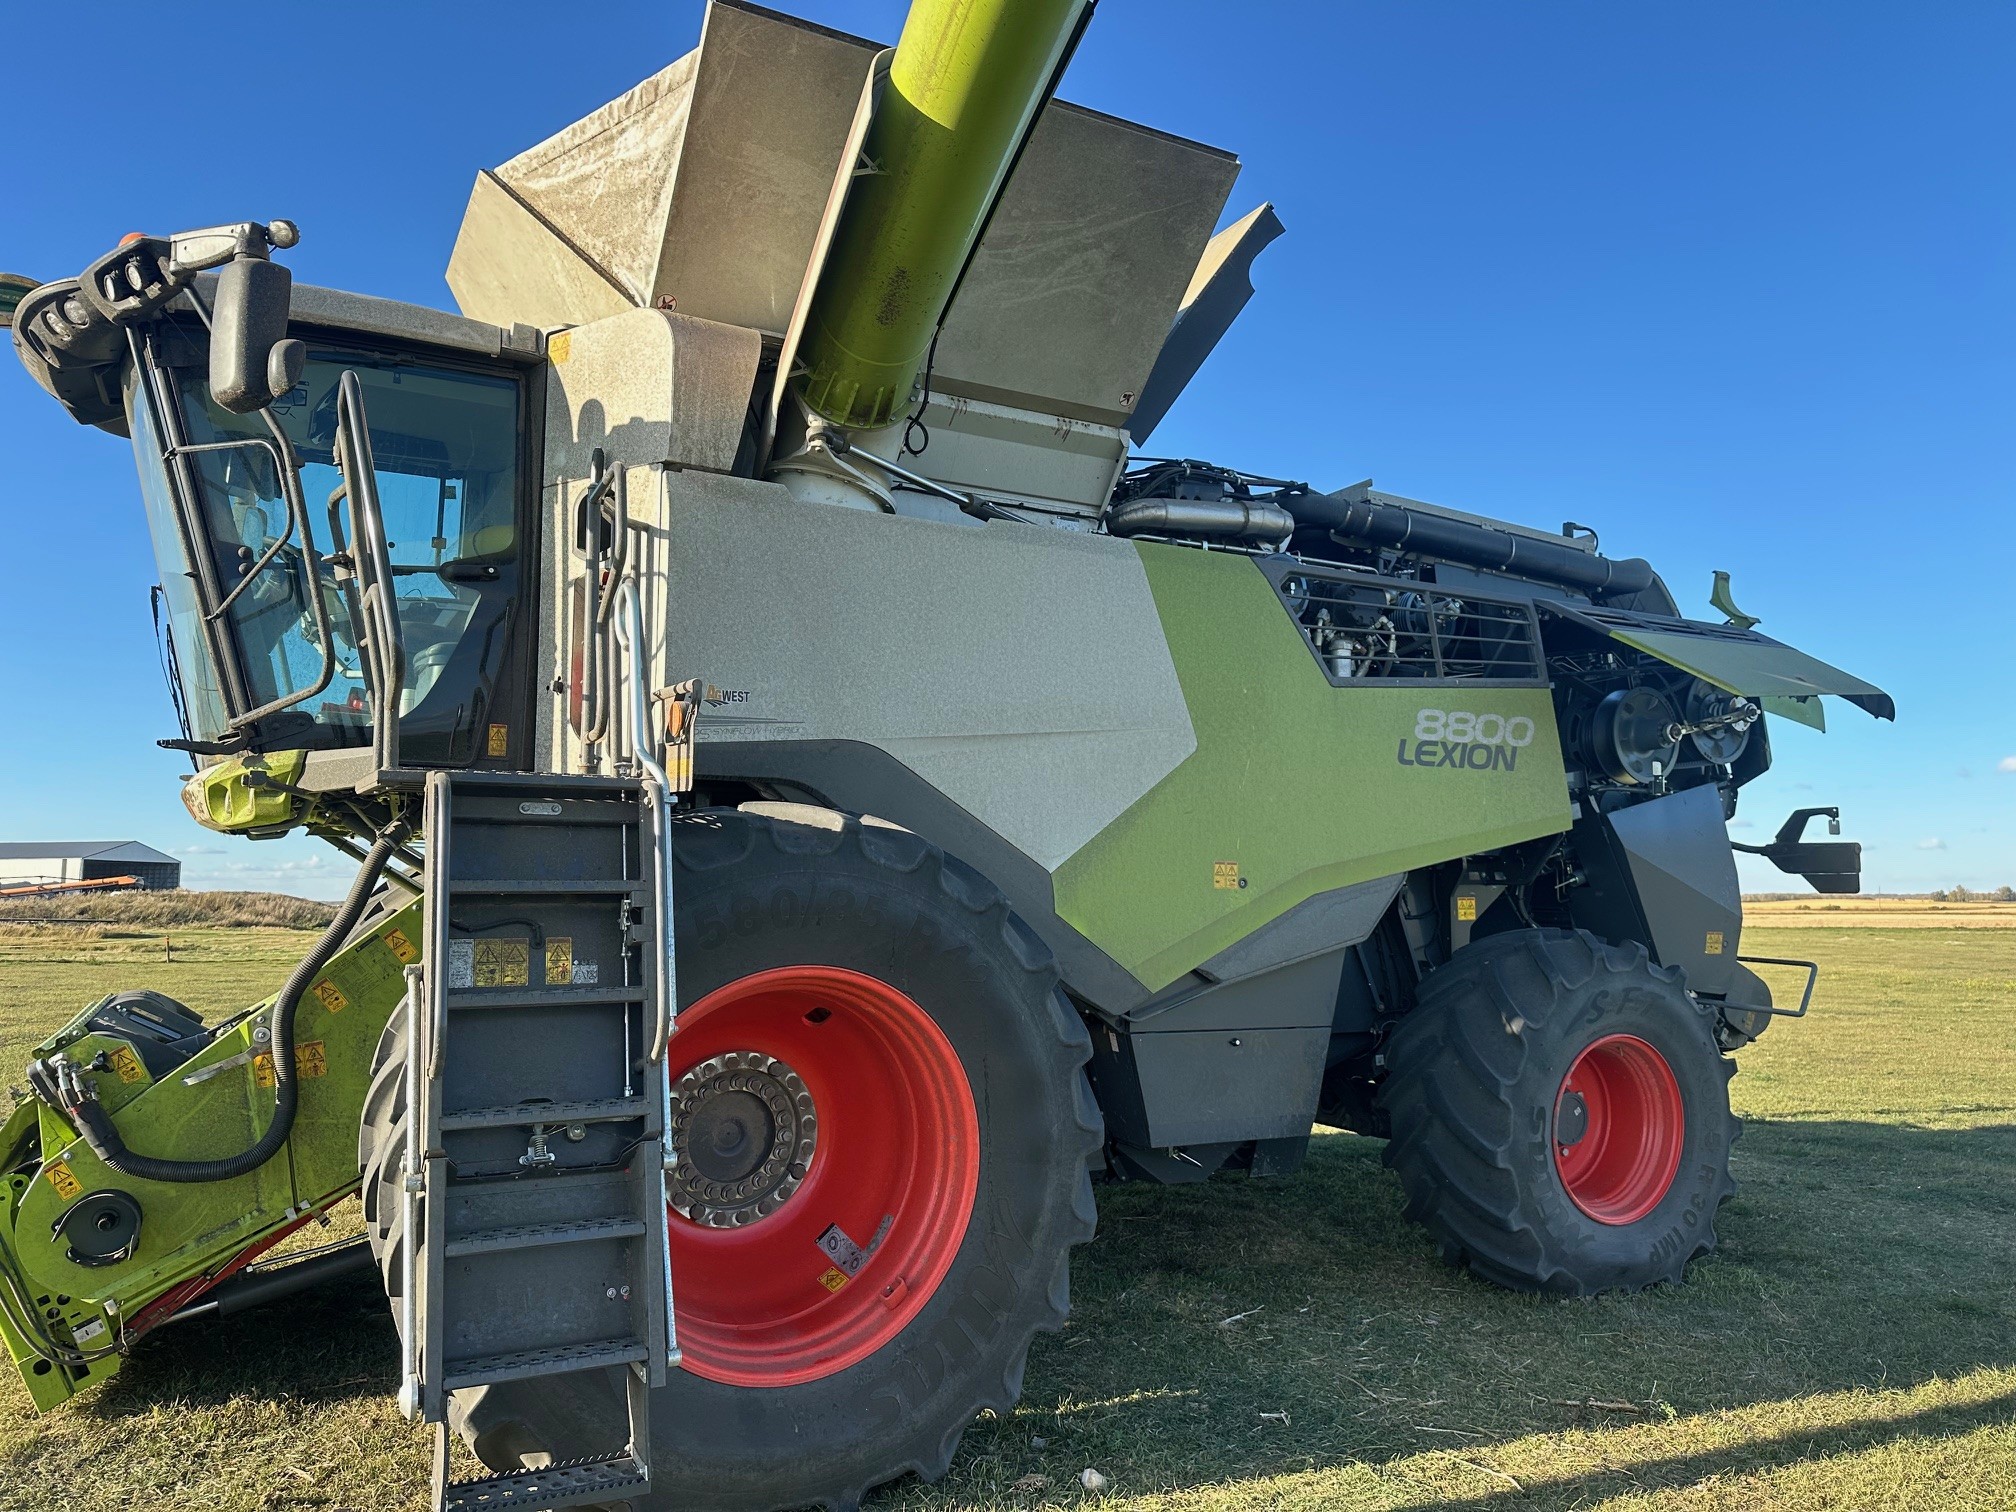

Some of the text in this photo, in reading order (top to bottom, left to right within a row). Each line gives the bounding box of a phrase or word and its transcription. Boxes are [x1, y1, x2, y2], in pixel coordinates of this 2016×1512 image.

[1414, 708, 1535, 747] 8800
[1397, 738, 1518, 772] LEXION
[692, 876, 889, 952] 580/85
